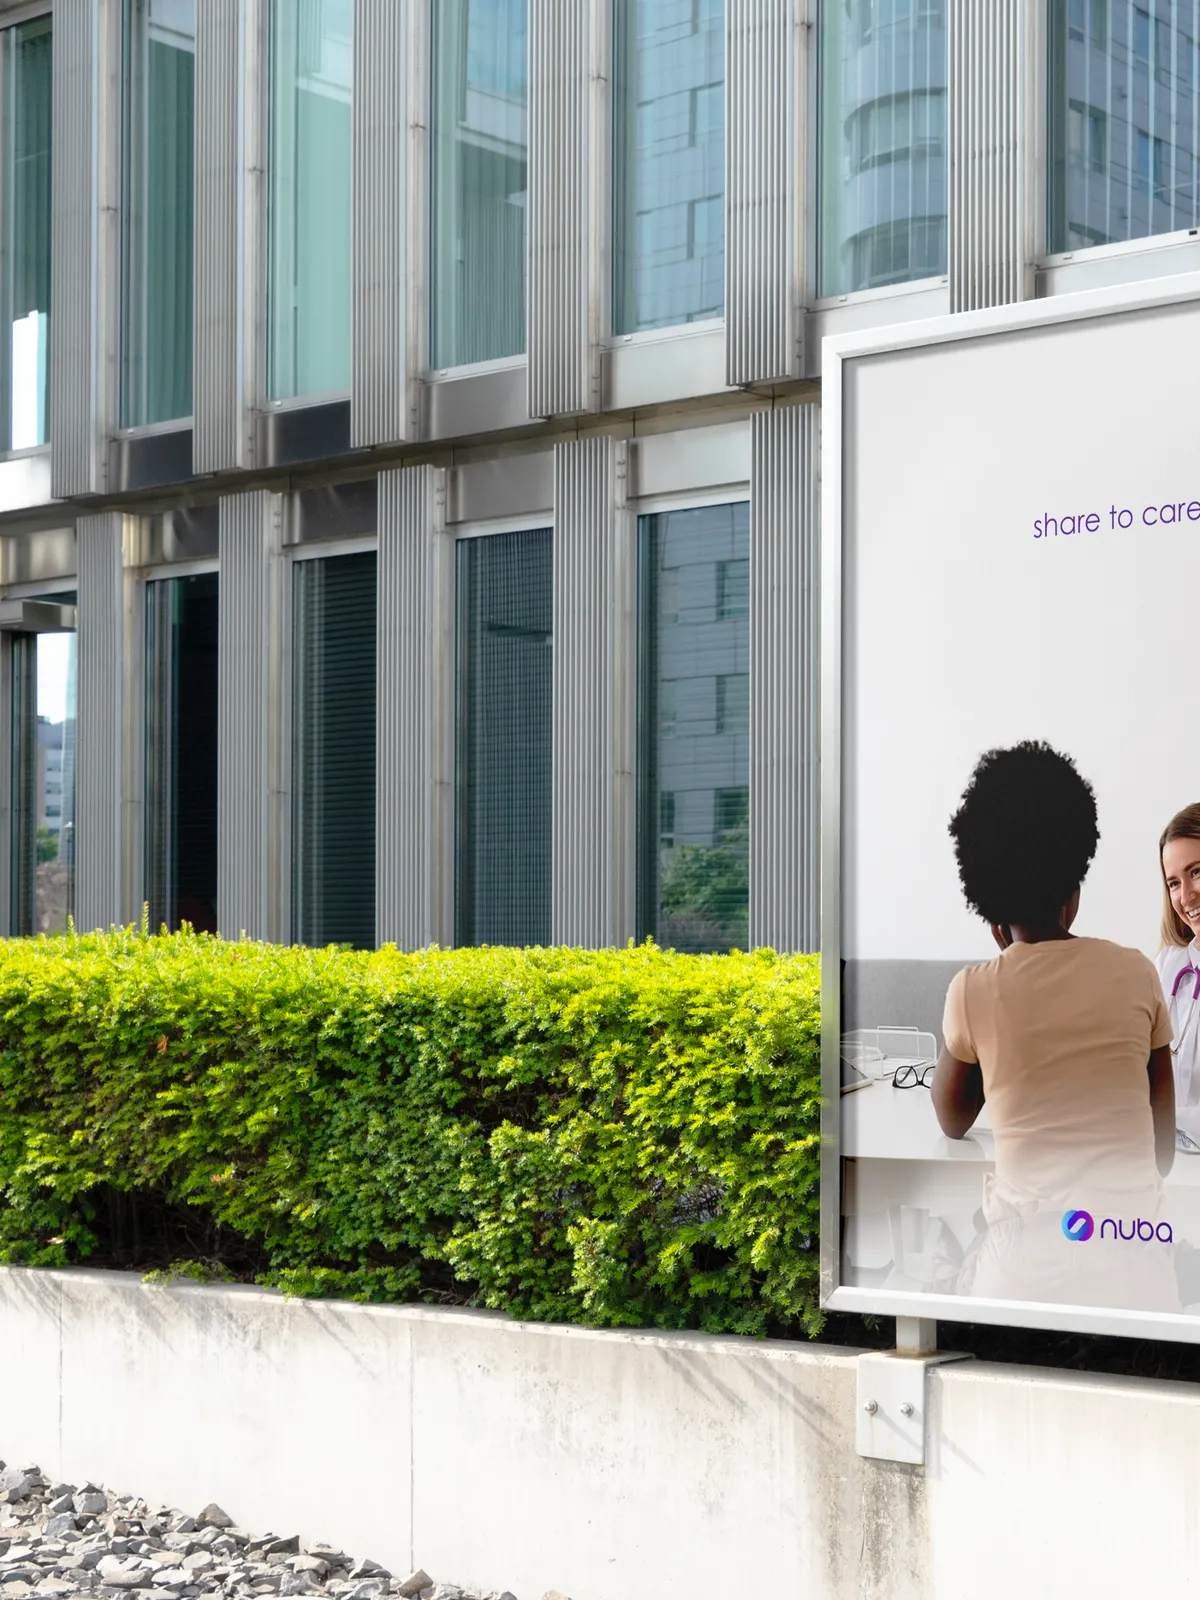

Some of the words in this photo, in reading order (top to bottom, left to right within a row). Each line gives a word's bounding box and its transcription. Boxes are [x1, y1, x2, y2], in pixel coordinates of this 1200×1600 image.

[1033, 512, 1101, 539] share
[1109, 504, 1134, 530] to
[1100, 1217, 1173, 1244] nuba
